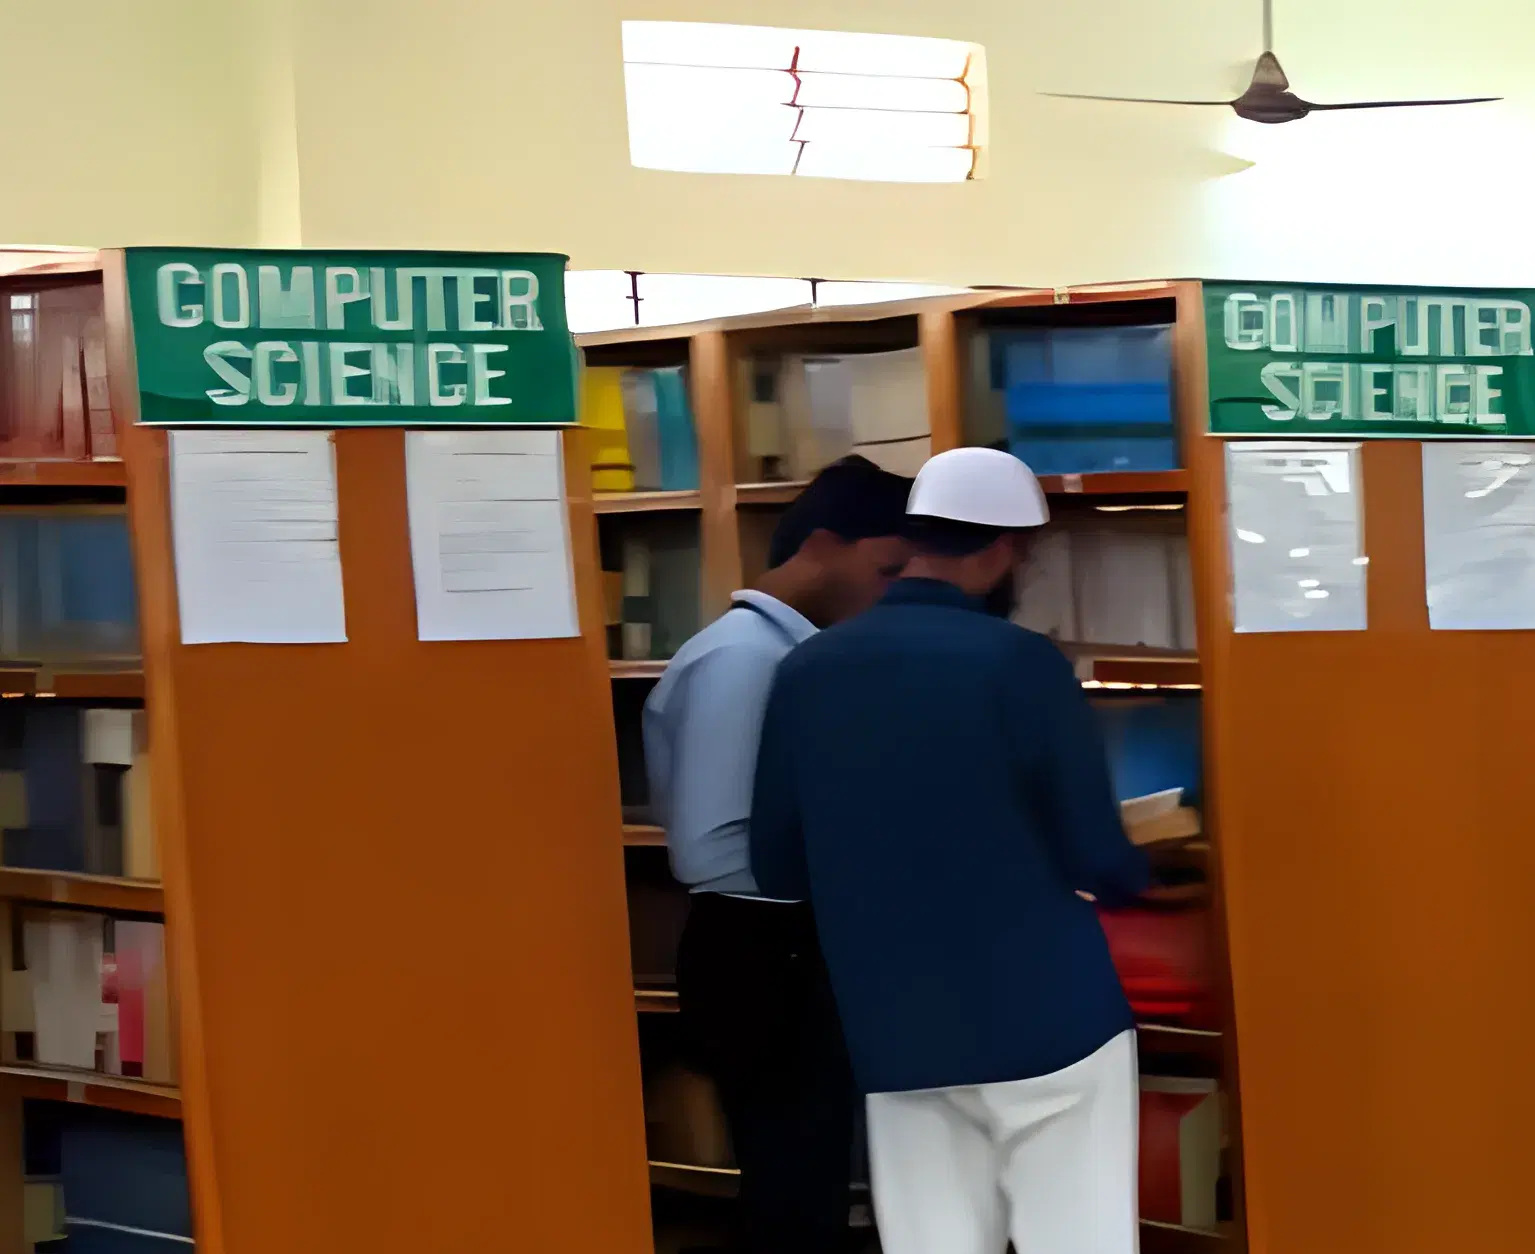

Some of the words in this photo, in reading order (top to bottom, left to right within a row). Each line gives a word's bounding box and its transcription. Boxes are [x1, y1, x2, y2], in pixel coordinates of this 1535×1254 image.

[156, 262, 544, 331] COMPUTER
[1223, 292, 1534, 356] COMPUTER
[203, 340, 513, 407] SCIENCE
[1260, 361, 1506, 425] SCIENCE
